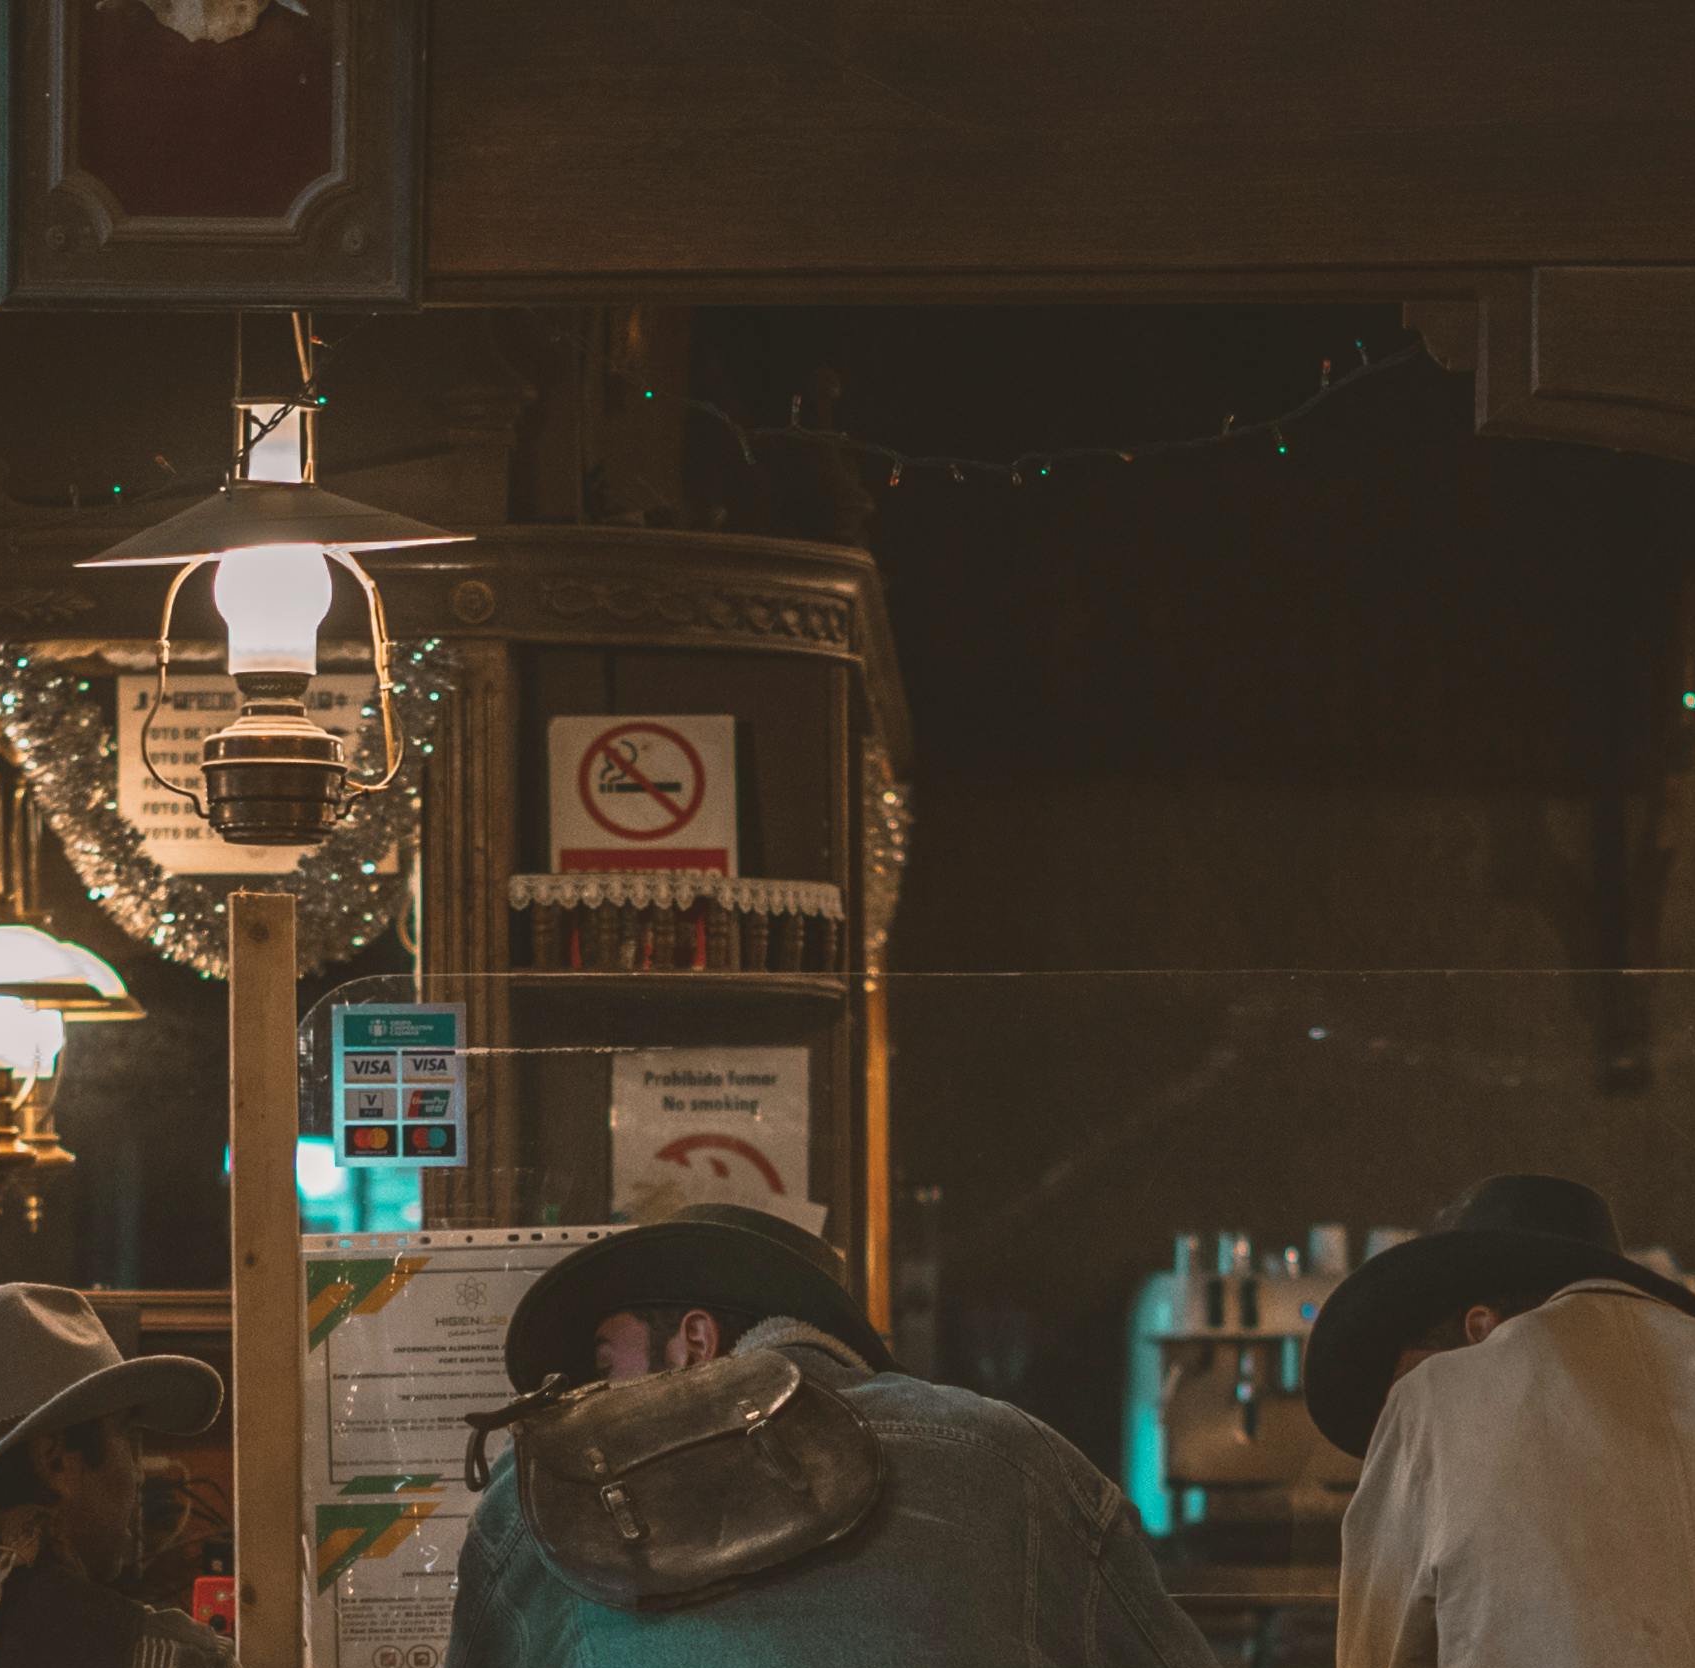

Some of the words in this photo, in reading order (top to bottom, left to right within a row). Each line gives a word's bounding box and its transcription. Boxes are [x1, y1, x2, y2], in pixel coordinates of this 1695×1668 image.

[352, 1060, 392, 1075] VISA
[411, 1058, 448, 1072] VISA
[644, 1070, 722, 1086] Prohibido
[728, 1071, 777, 1086] fumar
[365, 1094, 377, 1106] V
[663, 1096, 685, 1111] No
[690, 1094, 760, 1115] smoking
